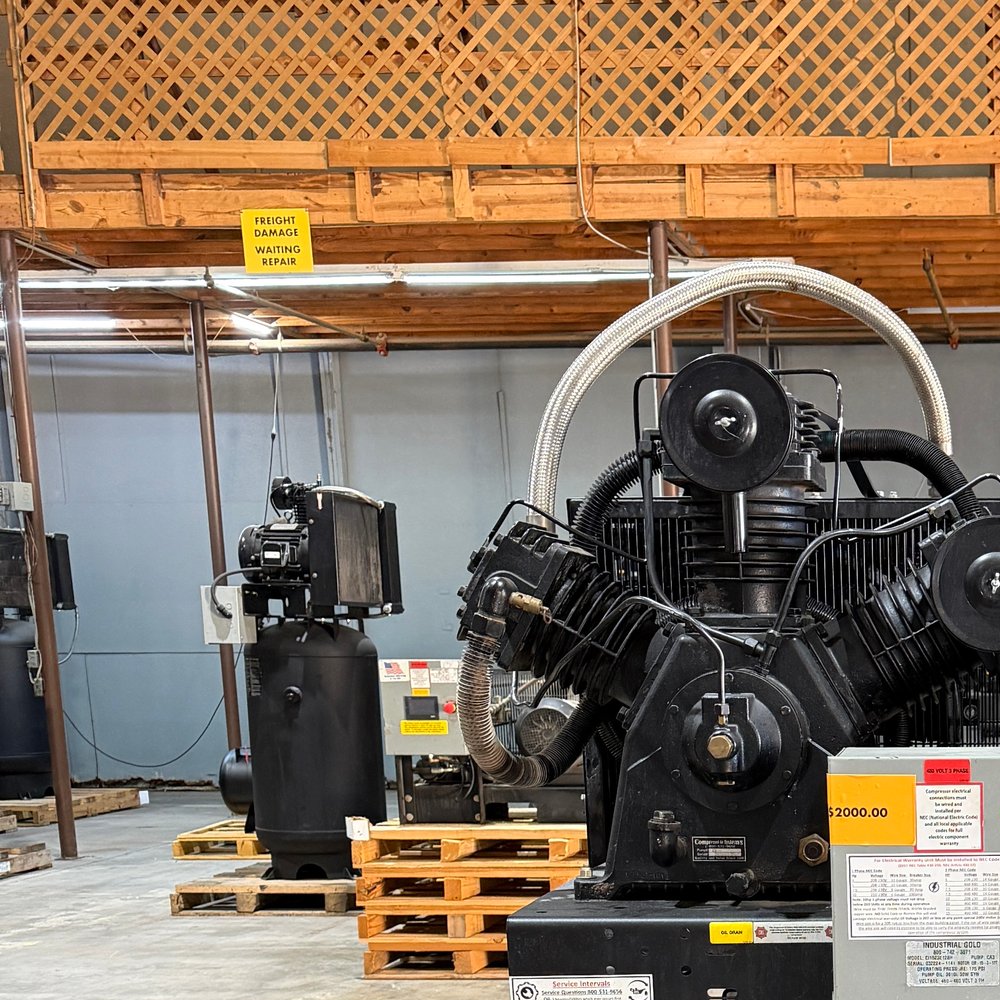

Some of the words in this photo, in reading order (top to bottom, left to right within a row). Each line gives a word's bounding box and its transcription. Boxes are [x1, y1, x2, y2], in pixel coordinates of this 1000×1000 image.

[255, 216, 295, 225] FREIGHT
[254, 228, 298, 237] DAMAGE
[255, 245, 301, 254] WAITING
[262, 258, 297, 266] REPAIR
[828, 806, 888, 817] $2000.00
